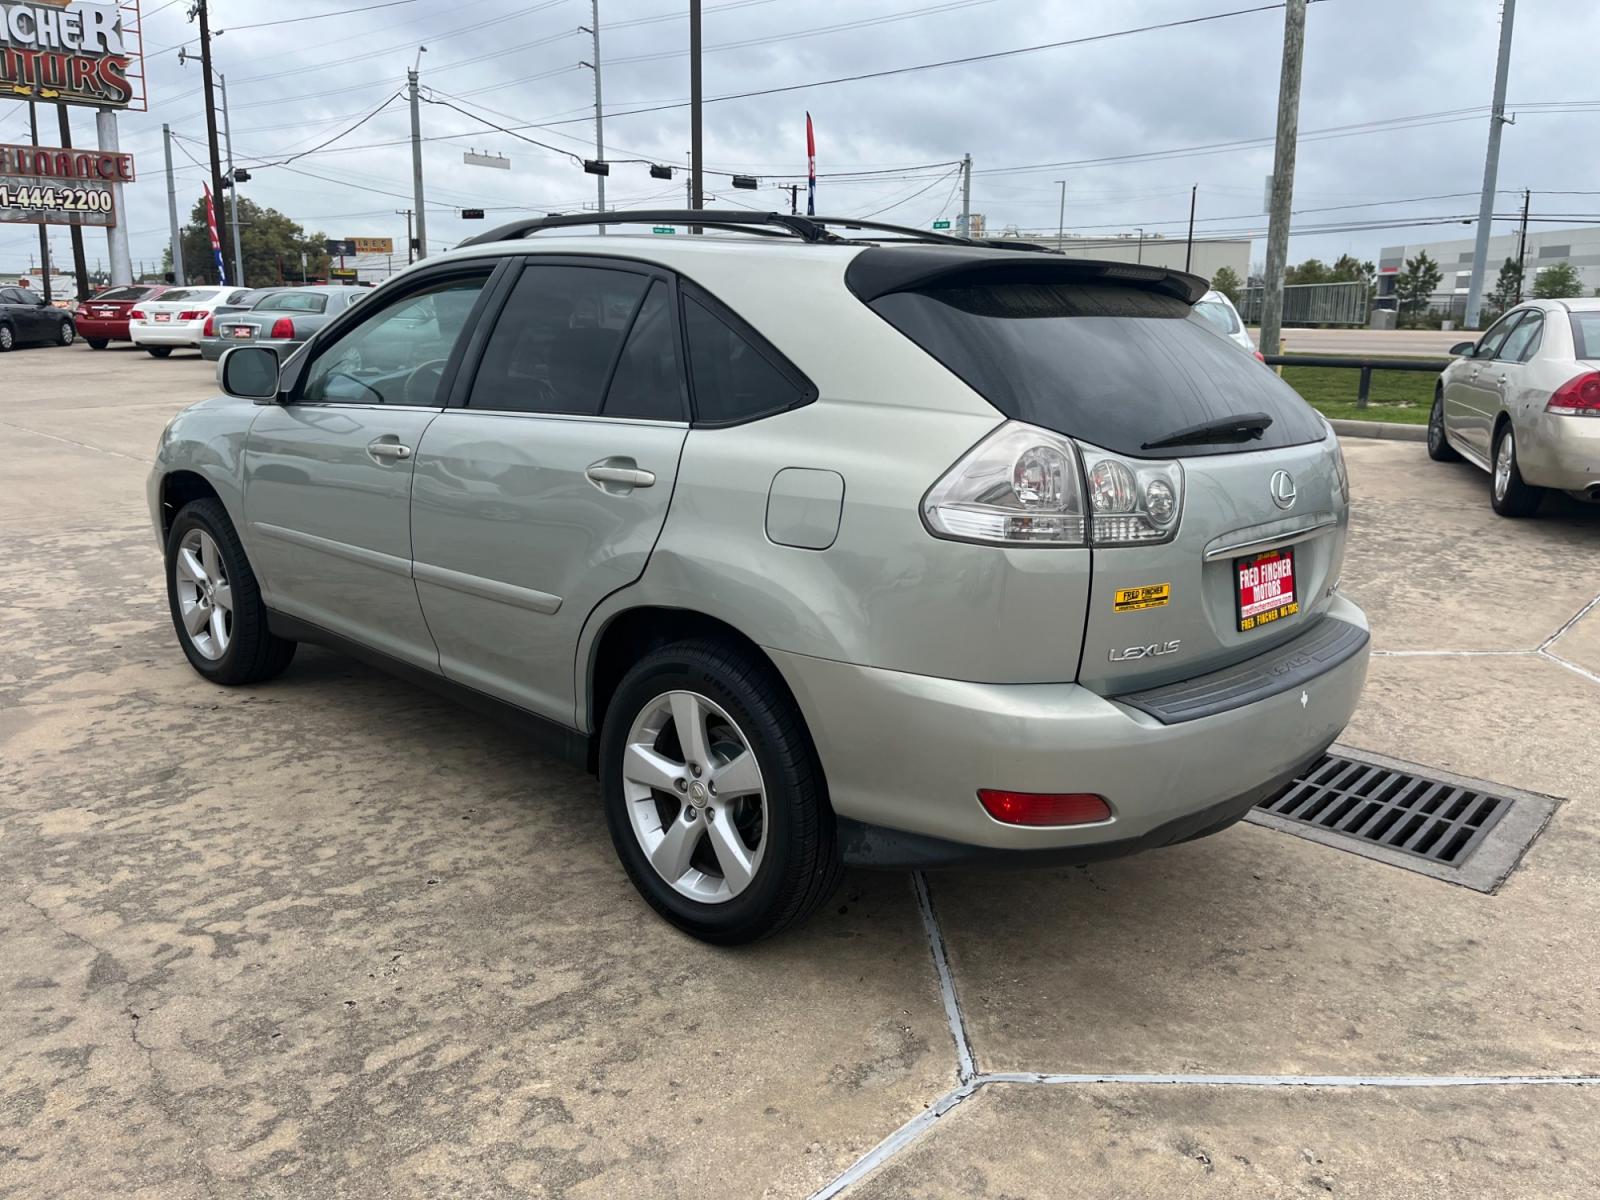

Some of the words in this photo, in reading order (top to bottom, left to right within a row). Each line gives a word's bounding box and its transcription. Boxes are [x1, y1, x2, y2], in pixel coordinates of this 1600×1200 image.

[0, 149, 132, 179] INANCE
[1239, 566, 1260, 590] FRED
[1260, 558, 1292, 584] FINCHER
[1253, 579, 1281, 602] MOTORS
[1108, 639, 1181, 663] LEXUS
